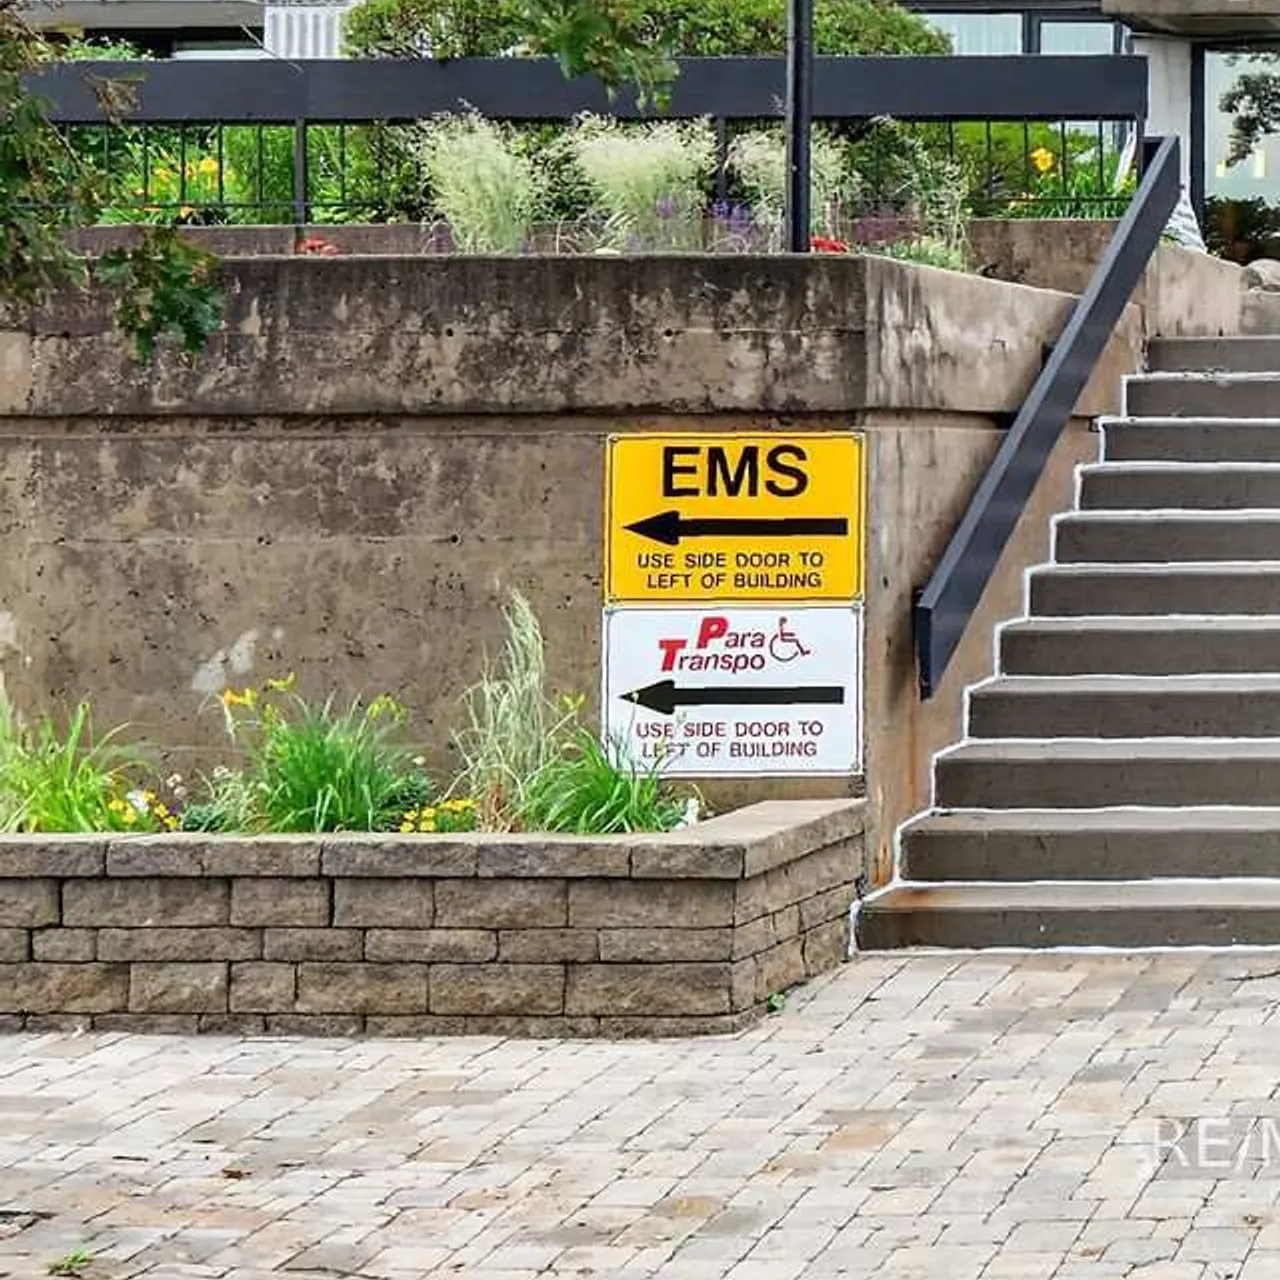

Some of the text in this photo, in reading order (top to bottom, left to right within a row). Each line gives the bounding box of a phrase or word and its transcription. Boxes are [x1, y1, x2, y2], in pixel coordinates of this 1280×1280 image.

[662, 444, 809, 499] EMS
[637, 551, 824, 569] USE SIDE DOOR TO
[647, 572, 823, 590] LEFT OF BUILDING
[696, 616, 766, 650] Para
[658, 639, 766, 674] Transpo
[636, 720, 824, 738] USE SIDE DOOR TO
[642, 741, 818, 759] LEFT OF BUILDING
